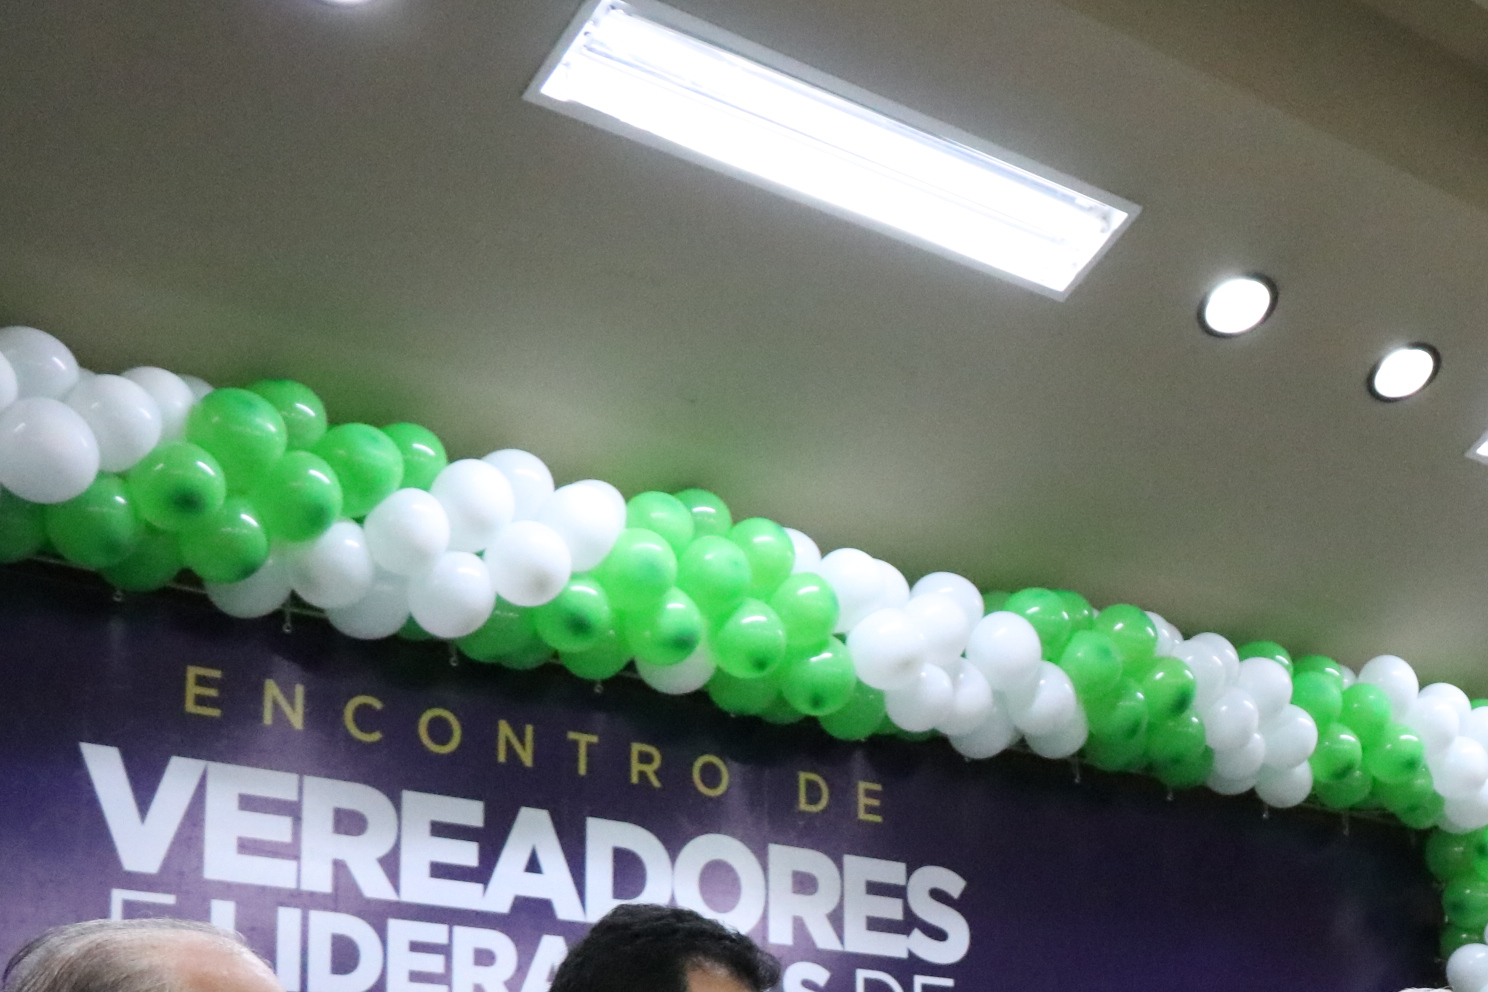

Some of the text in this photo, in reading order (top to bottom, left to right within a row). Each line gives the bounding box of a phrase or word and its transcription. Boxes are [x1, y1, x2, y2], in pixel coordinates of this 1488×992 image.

[183, 664, 884, 823] ENCONTRO DE
[78, 741, 971, 965] VEREADORES
